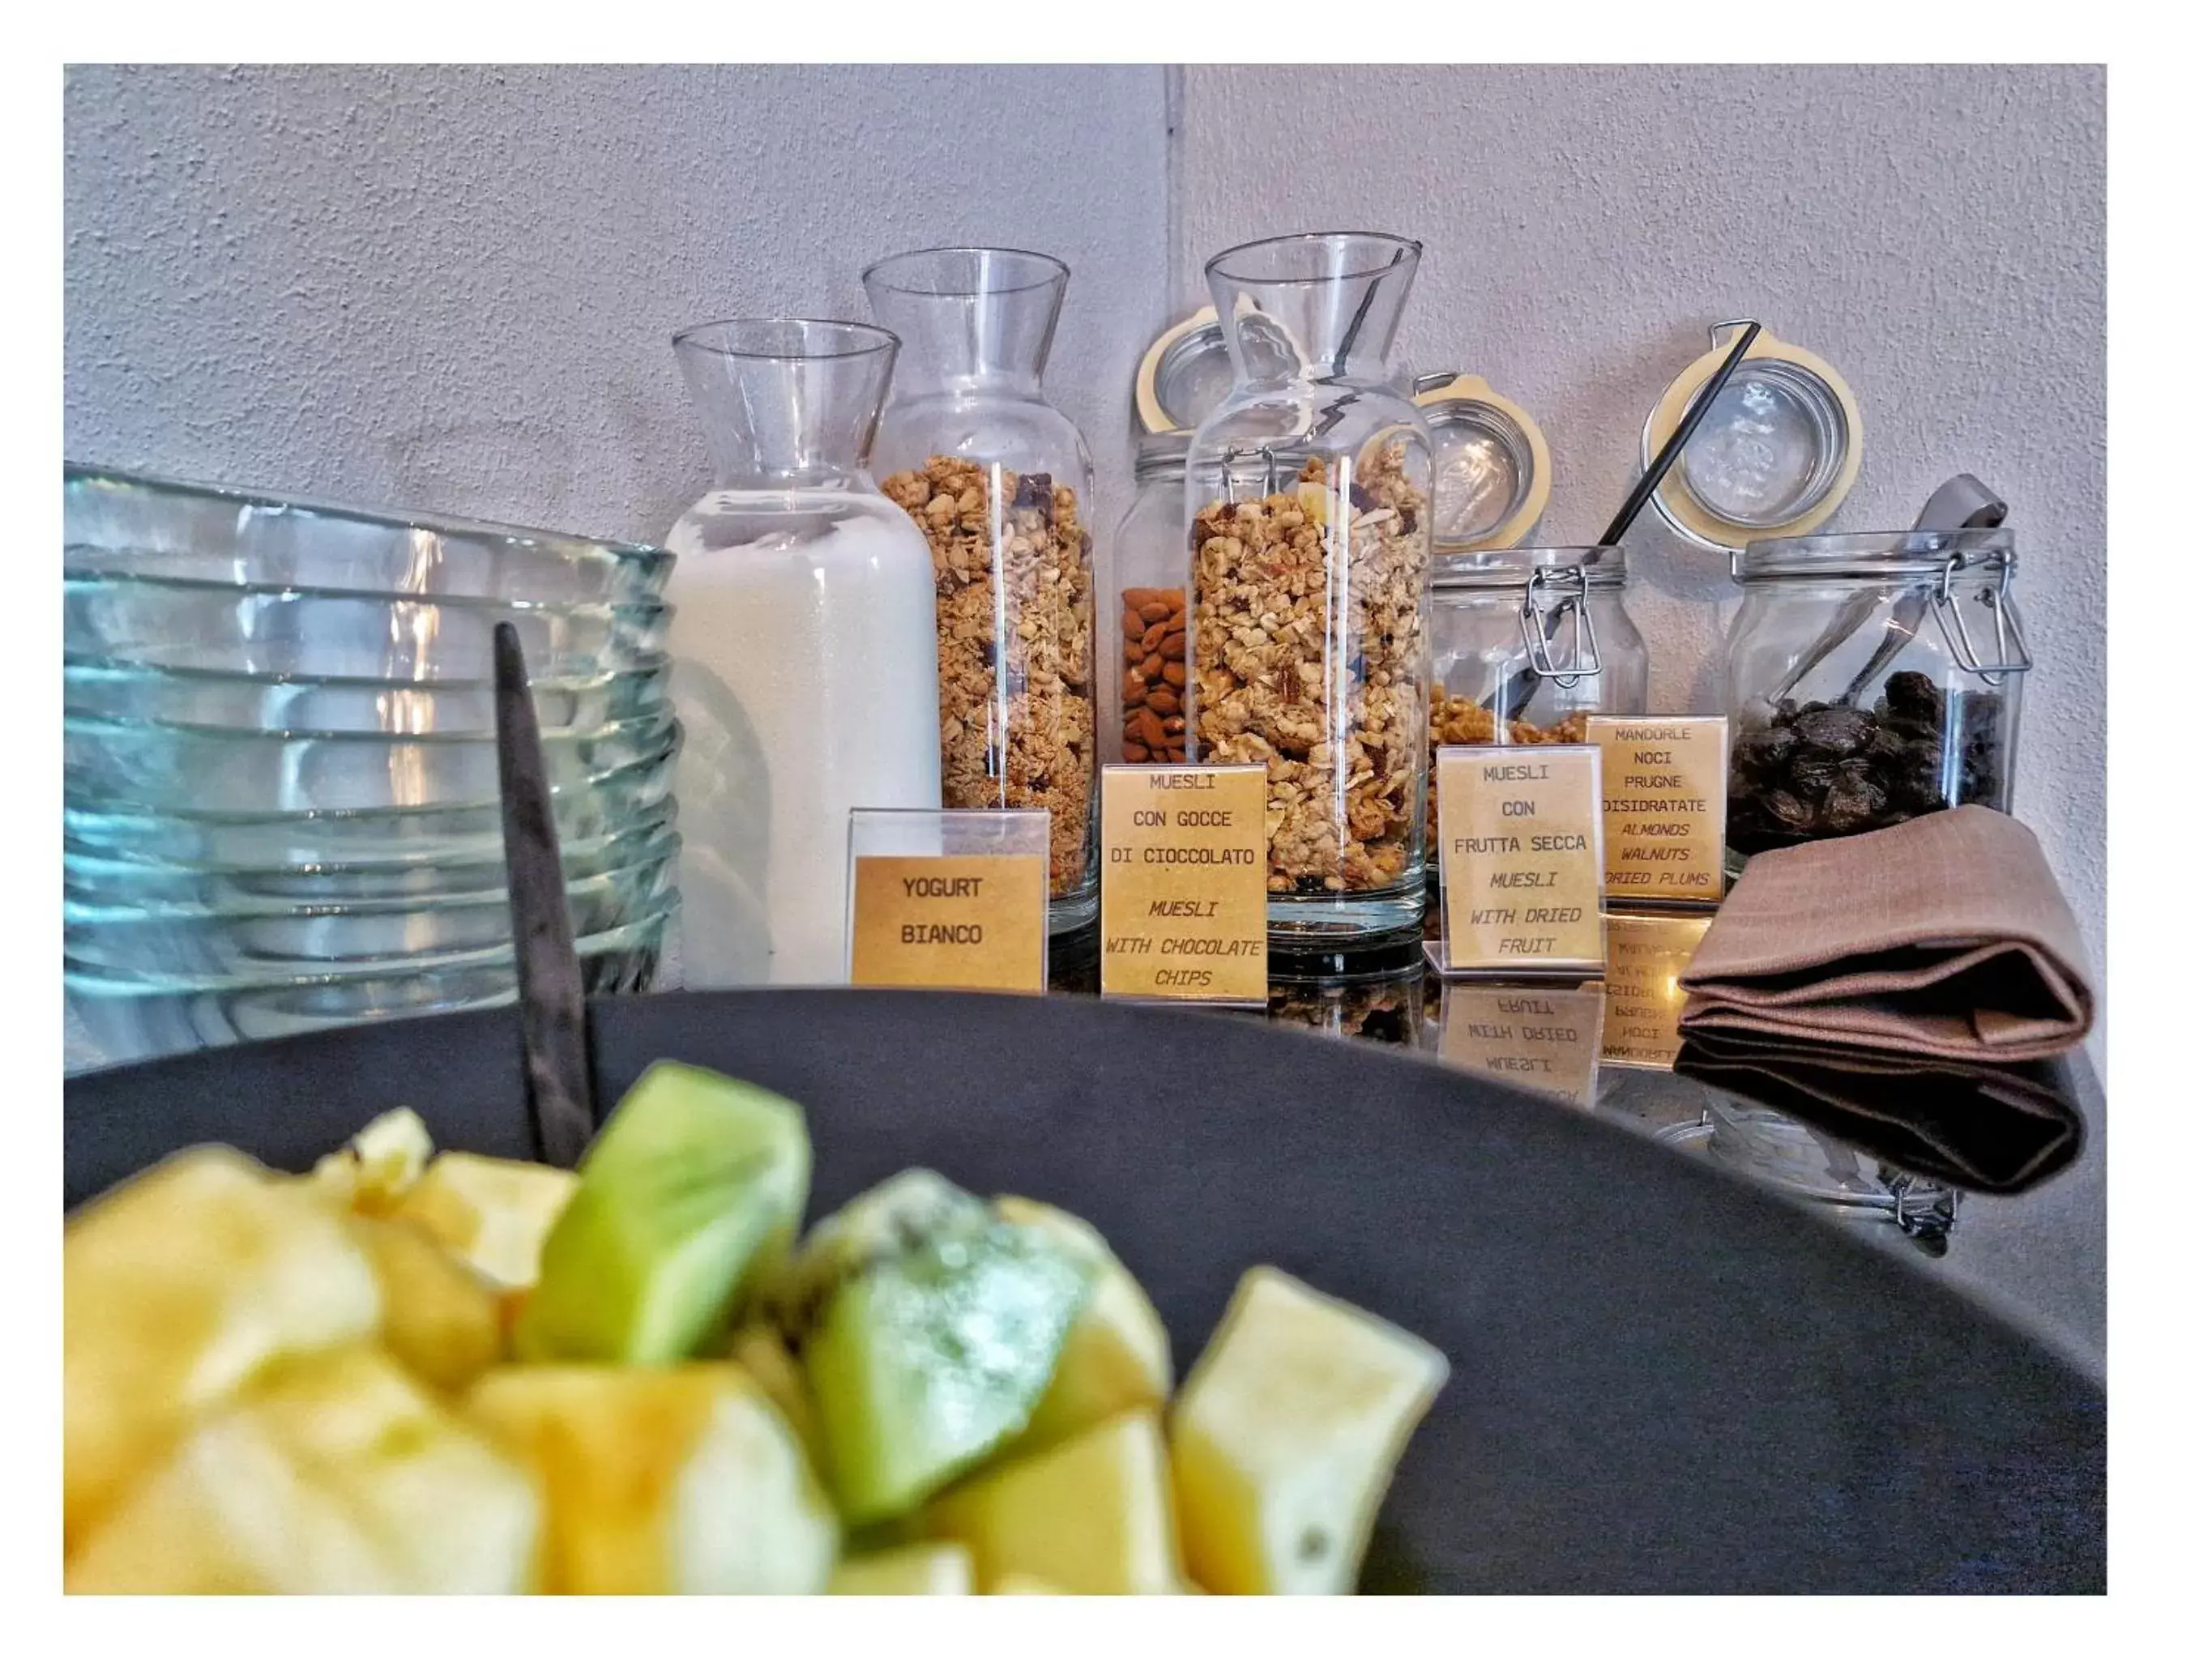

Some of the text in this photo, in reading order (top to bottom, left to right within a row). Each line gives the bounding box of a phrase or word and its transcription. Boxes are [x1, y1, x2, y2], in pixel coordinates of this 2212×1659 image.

[1615, 727, 1692, 741] MANDORLE
[1634, 751, 1672, 765] NOCI
[1150, 774, 1215, 790] MUESLI
[1483, 765, 1550, 782] MUESLI
[1624, 775, 1683, 789] PRUGNE
[1501, 800, 1535, 817] CON
[1603, 799, 1706, 812] DISIDRATATE
[1134, 811, 1232, 827] CON GOCCE
[1621, 822, 1690, 837] ALMONDS
[1454, 835, 1586, 855] FRUTTA SECCA
[1111, 847, 1255, 865] DI CIOCCOLATO
[1621, 847, 1690, 861] WALNUTS
[903, 877, 983, 898] YOGURT
[1490, 872, 1557, 889] MUESLI
[1605, 872, 1710, 886] DRIED PLUMS
[1148, 901, 1219, 918] MUESLI
[1470, 907, 1582, 925] WITH DRIED
[901, 924, 983, 945] BIANCO
[1106, 937, 1264, 957] WITH CHOCOLATE
[1498, 937, 1557, 954] FRUIT
[1155, 970, 1213, 987] CHIPS
